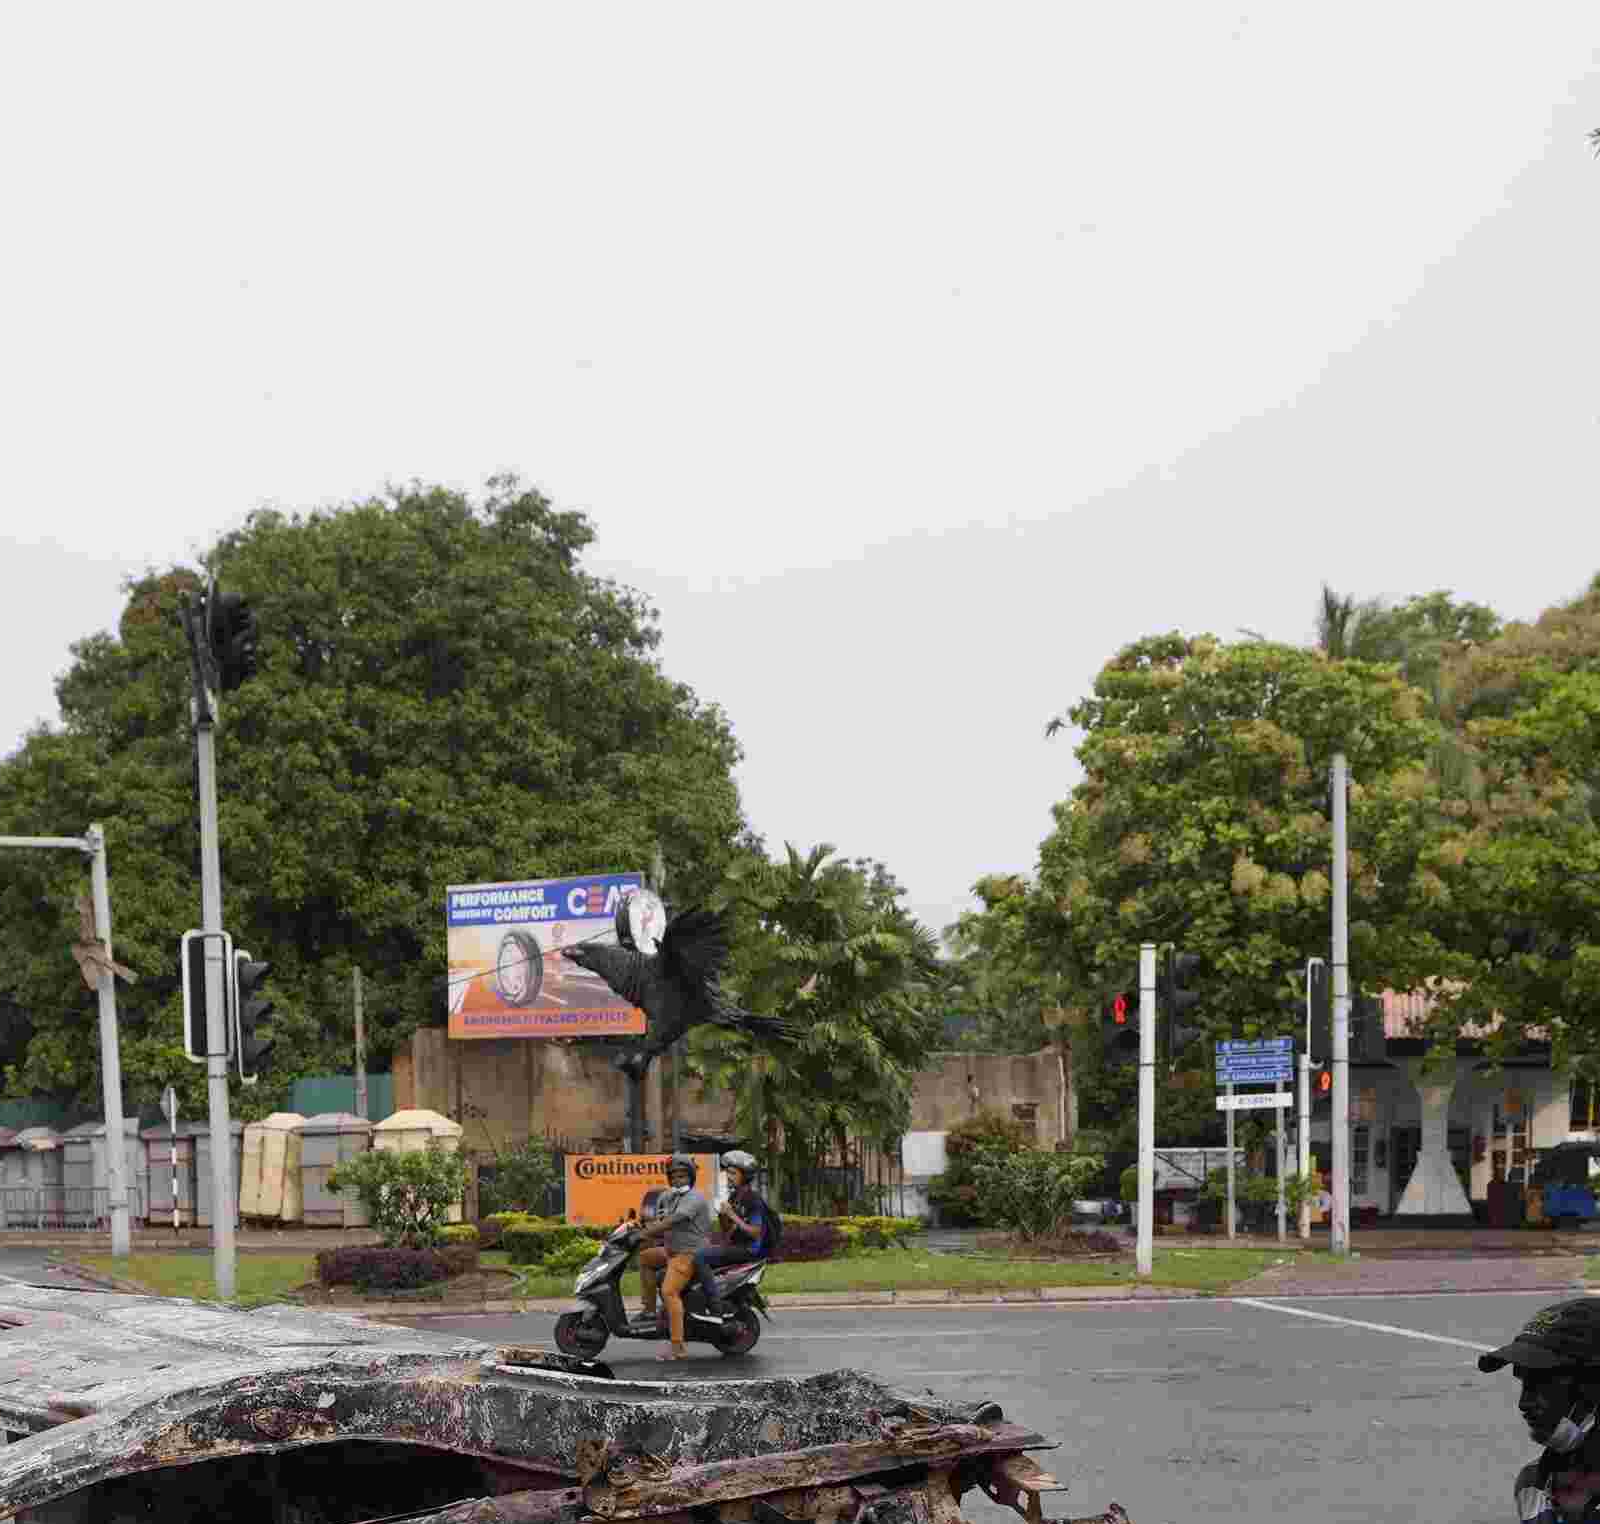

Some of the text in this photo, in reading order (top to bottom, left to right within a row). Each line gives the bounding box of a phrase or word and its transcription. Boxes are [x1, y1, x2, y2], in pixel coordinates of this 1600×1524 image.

[451, 888, 544, 908] PERFORMANCE
[494, 904, 557, 921] COMFORT
[575, 1157, 668, 1180] Continent
